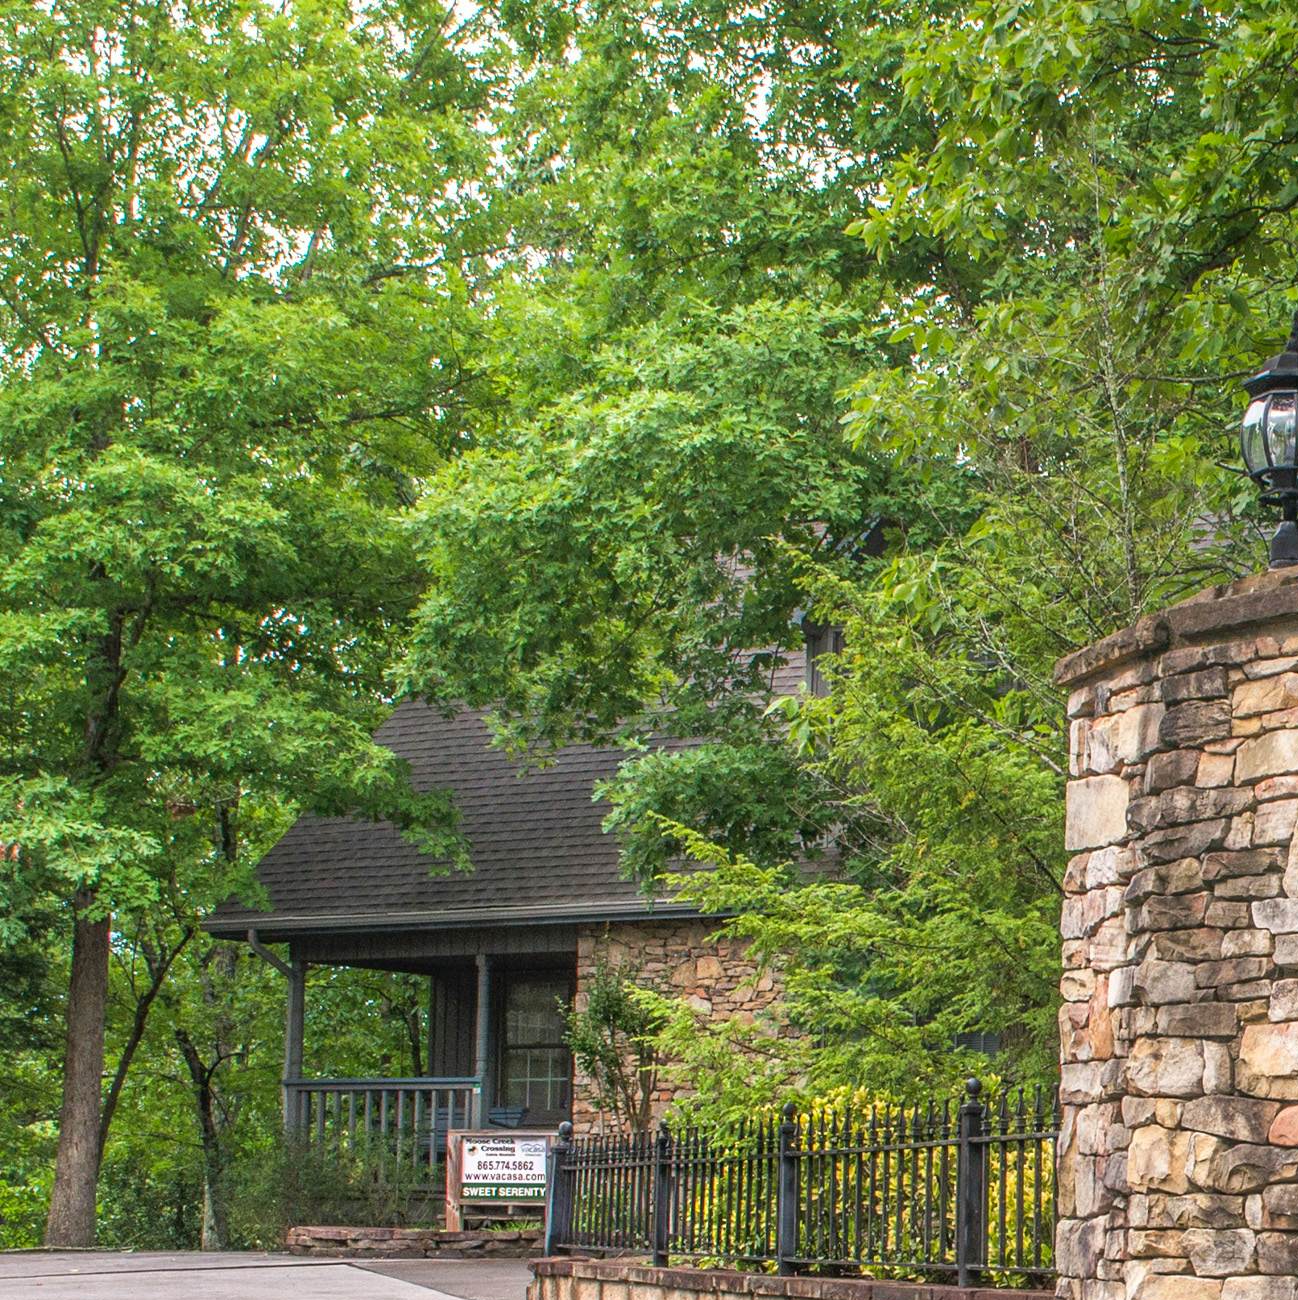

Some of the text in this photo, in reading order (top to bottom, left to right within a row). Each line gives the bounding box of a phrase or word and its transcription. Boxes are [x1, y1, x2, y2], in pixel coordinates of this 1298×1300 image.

[481, 1145, 516, 1153] Crossing
[477, 1160, 534, 1171] 865.774.5862
[465, 1173, 545, 1181] www.vacasa.com
[462, 1187, 546, 1197] SWEET SERENITY
